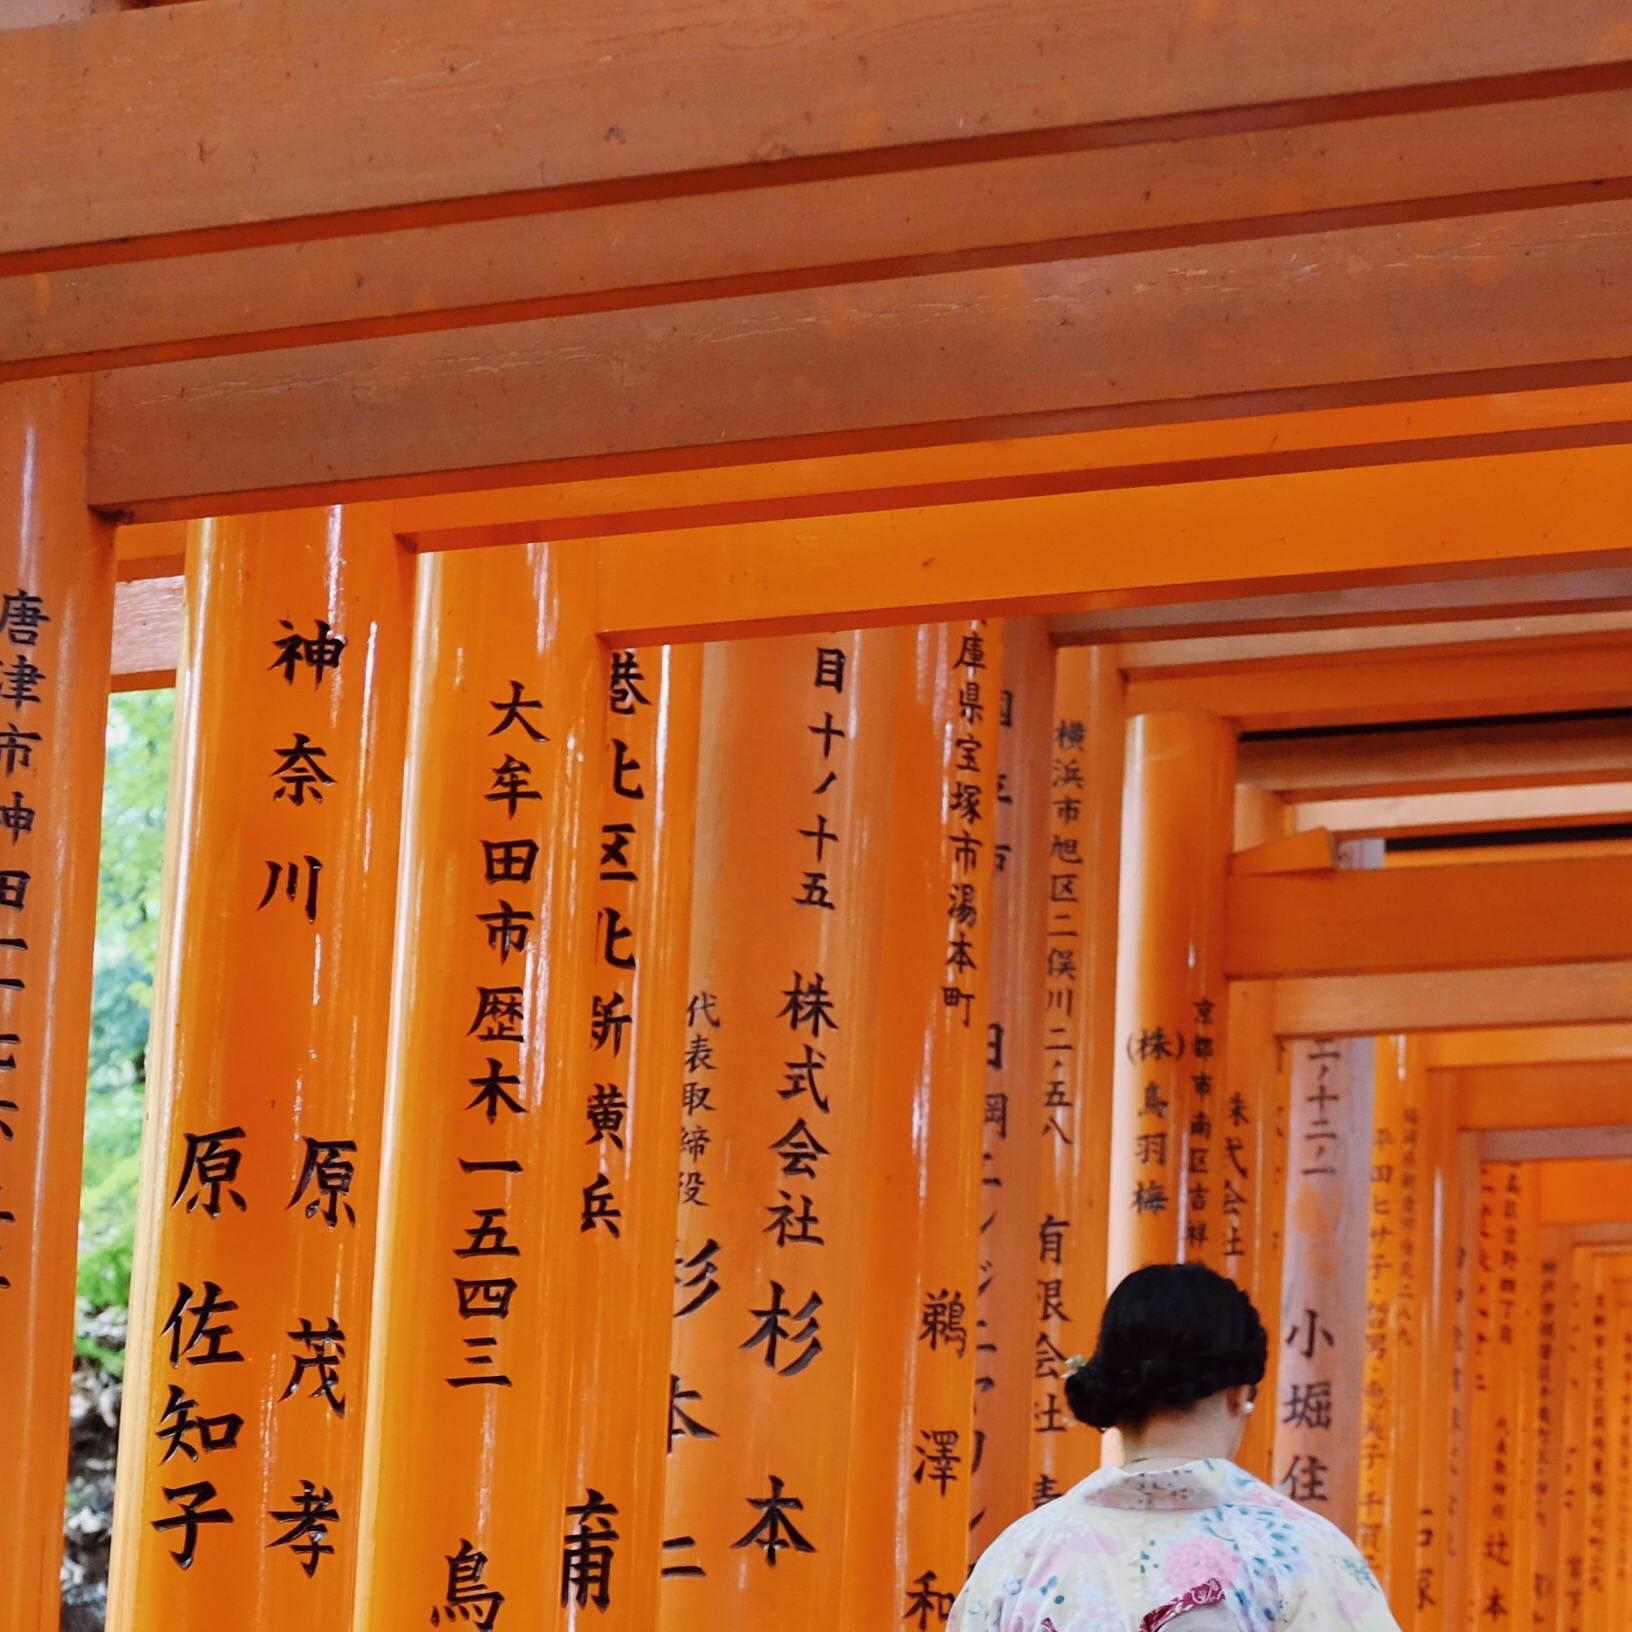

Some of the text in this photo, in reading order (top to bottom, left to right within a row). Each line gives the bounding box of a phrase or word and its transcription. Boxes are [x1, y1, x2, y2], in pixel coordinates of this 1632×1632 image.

[255, 618, 347, 924] 神奈川
[941, 619, 986, 1028] 庫県宝塚市湯本町
[1185, 998, 1216, 1262] 京都市南区吉祥
